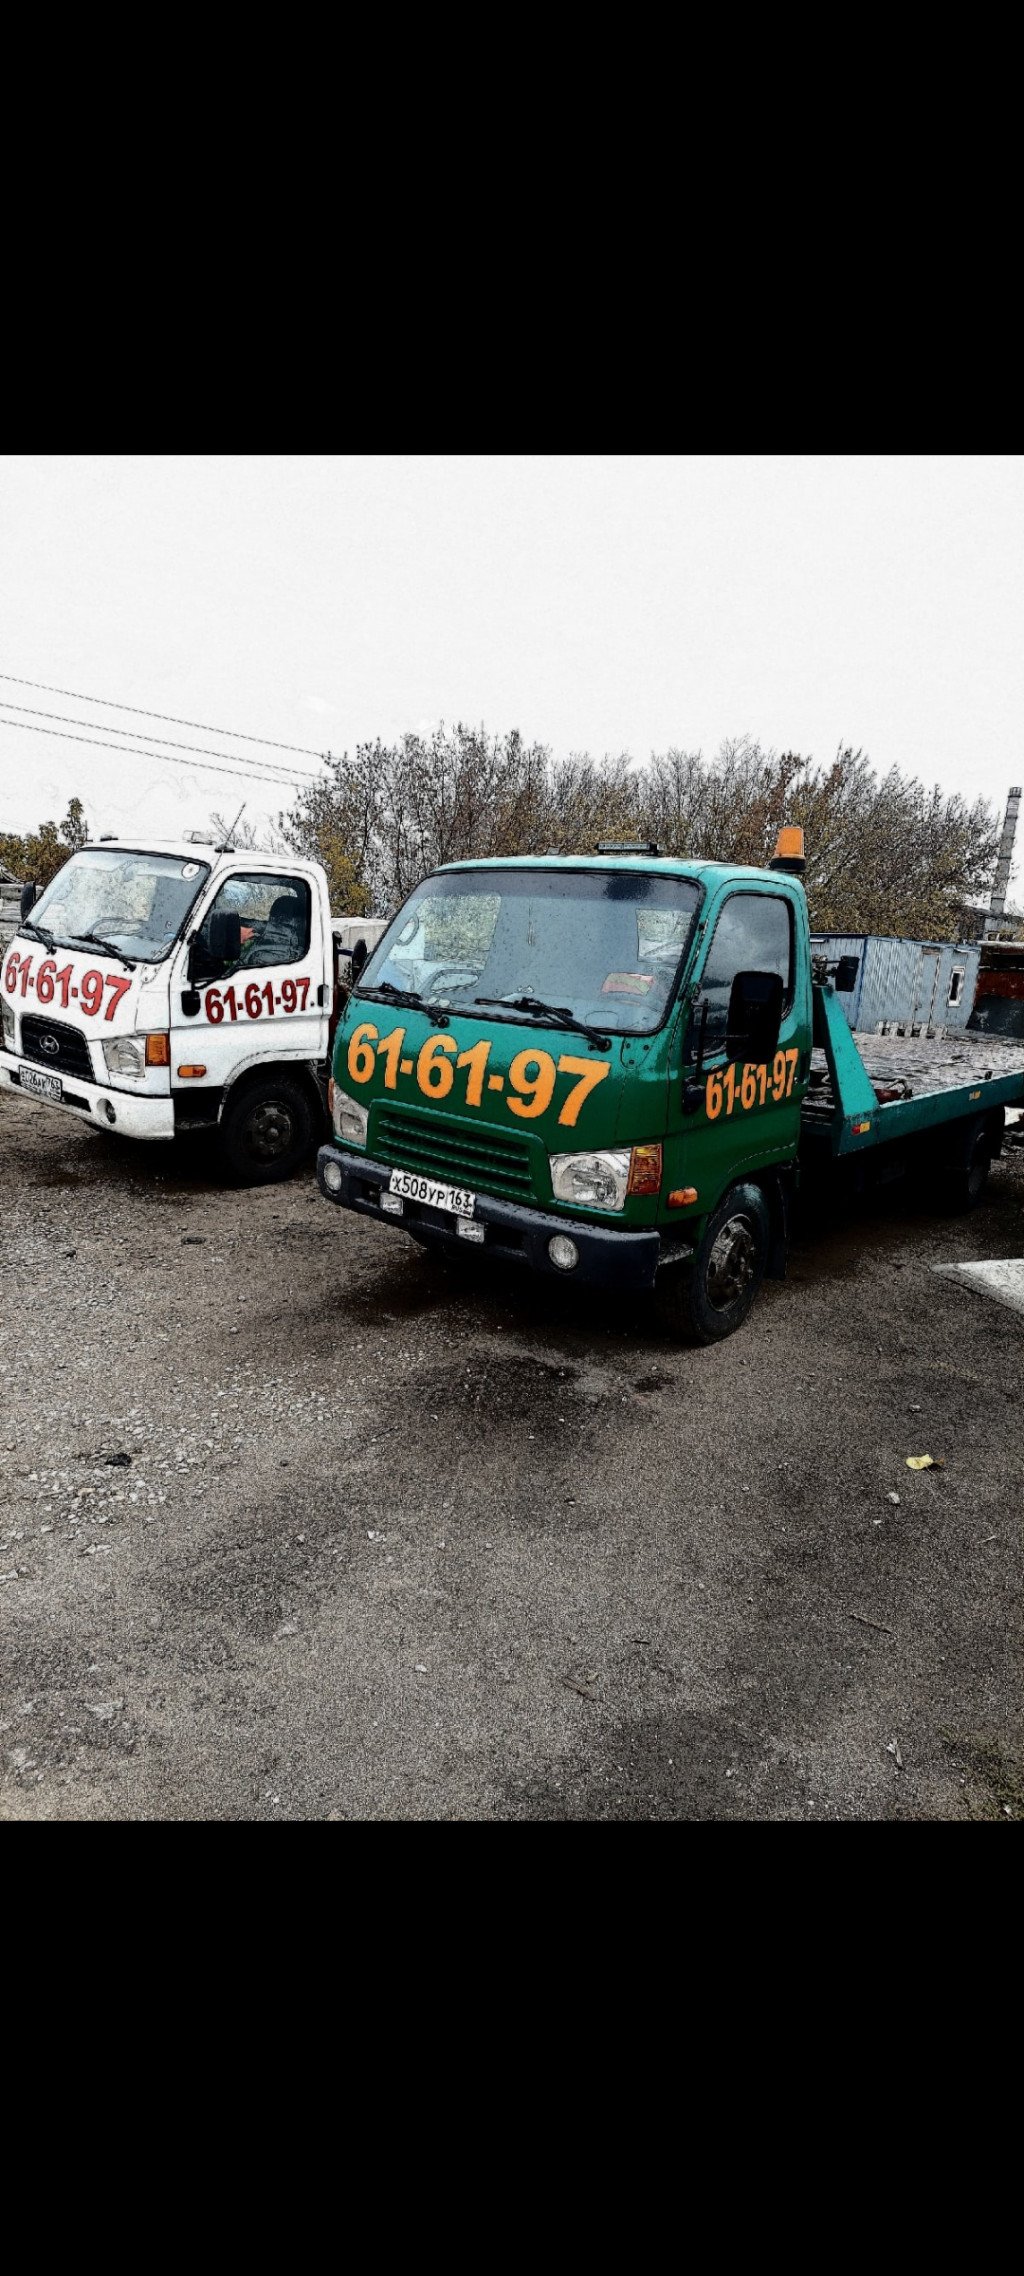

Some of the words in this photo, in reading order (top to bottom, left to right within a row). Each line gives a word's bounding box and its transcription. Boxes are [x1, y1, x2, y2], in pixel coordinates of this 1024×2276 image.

[5, 952, 132, 1021] 61-61-97
[205, 977, 310, 1024] 61-61-97
[347, 1023, 611, 1127] 61-61-97
[705, 1047, 799, 1120] 61-61-97
[449, 1190, 471, 1208] 163
